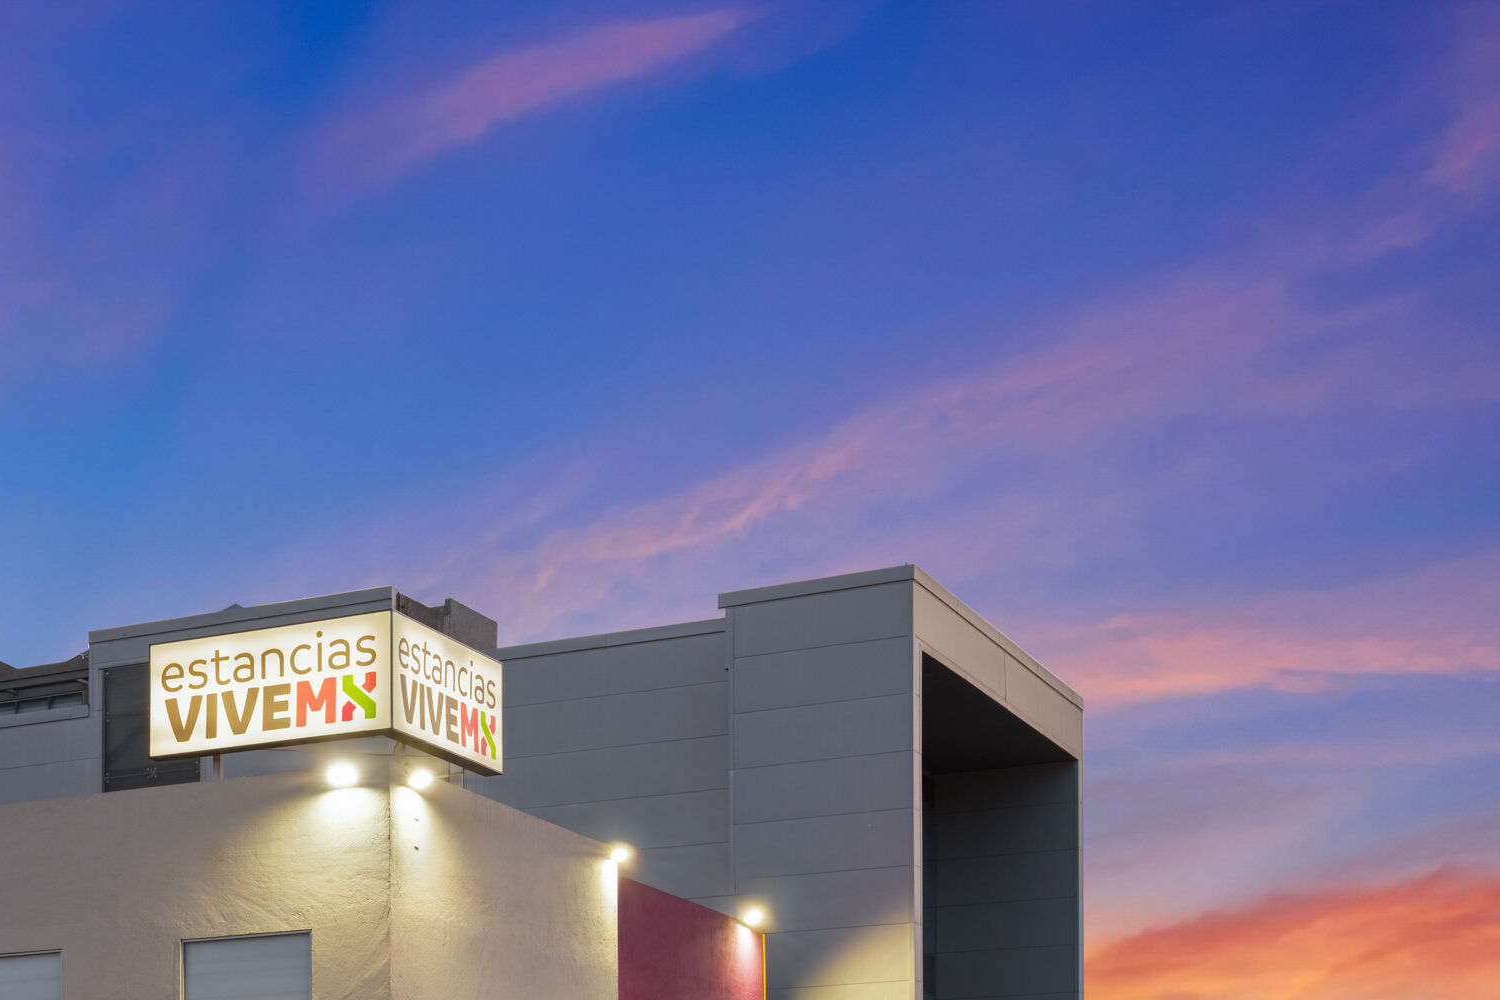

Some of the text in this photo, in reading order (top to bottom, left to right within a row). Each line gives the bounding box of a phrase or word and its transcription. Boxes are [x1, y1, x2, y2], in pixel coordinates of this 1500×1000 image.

[163, 631, 377, 692] estancias
[398, 637, 497, 709] estancias
[165, 672, 377, 742] VIVEMX
[399, 674, 498, 760] VIVEMX
